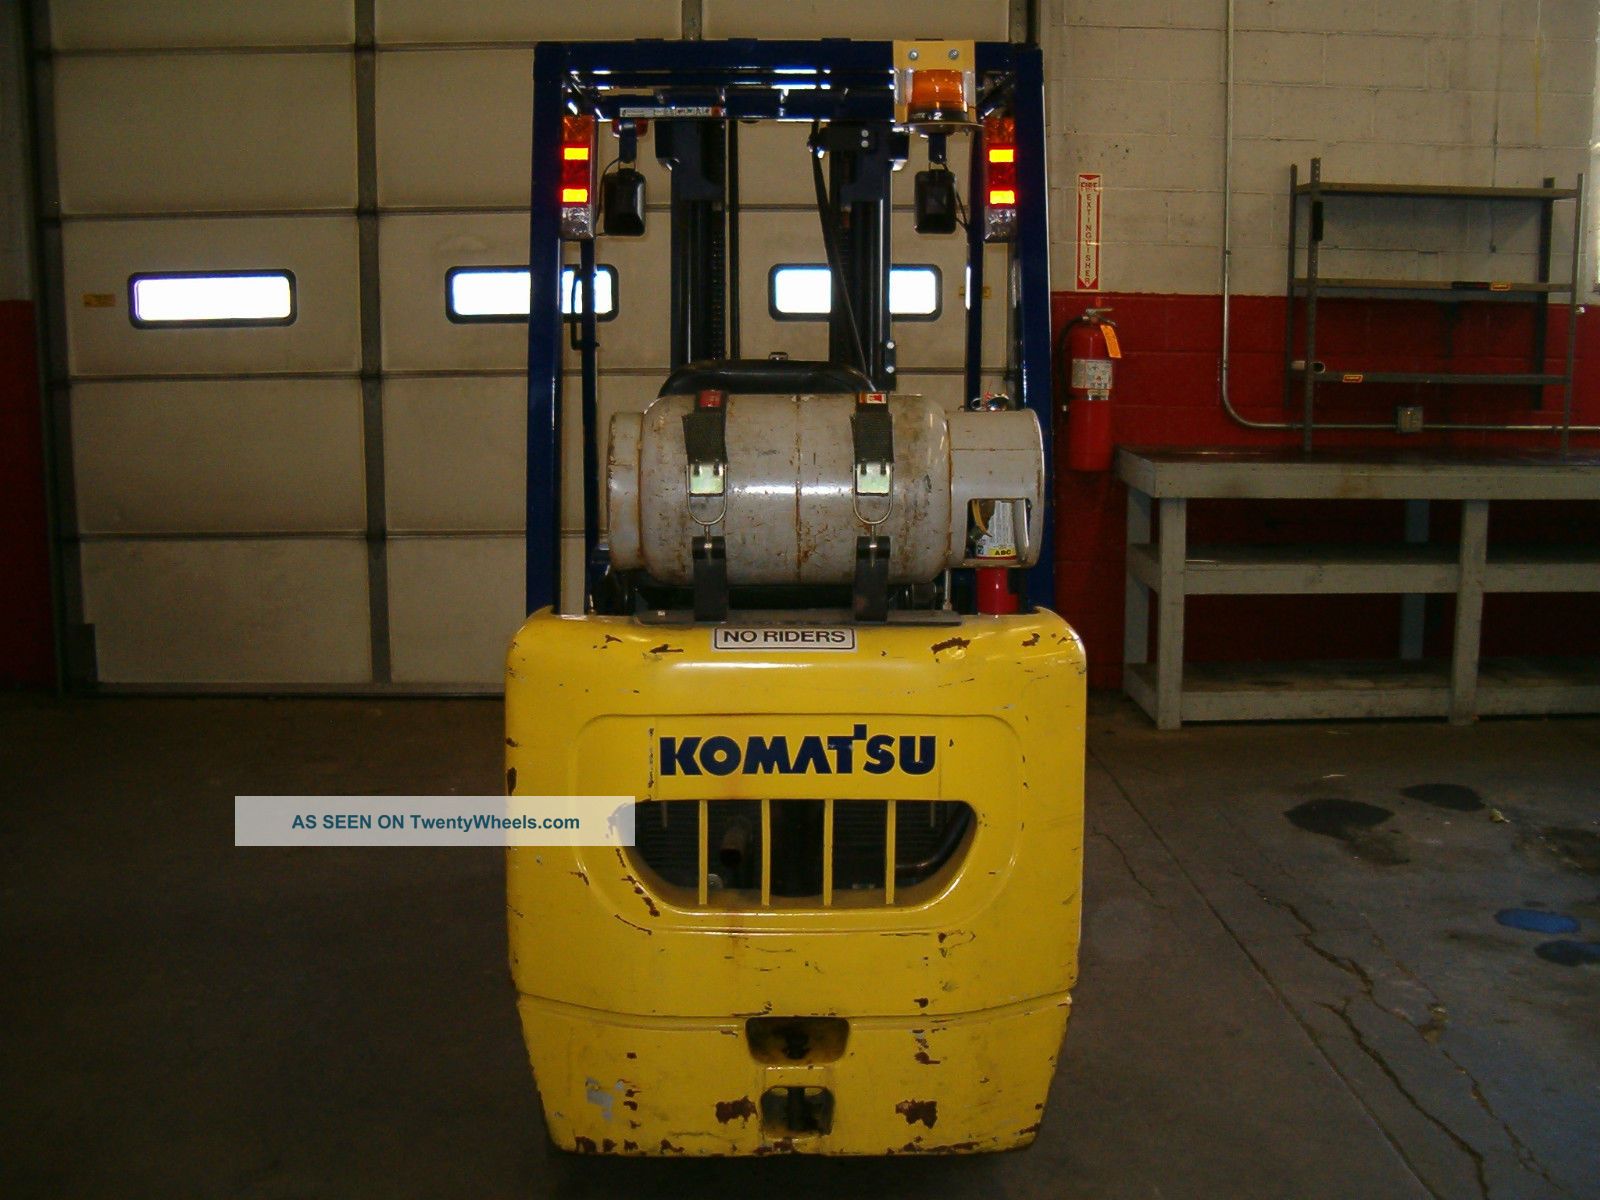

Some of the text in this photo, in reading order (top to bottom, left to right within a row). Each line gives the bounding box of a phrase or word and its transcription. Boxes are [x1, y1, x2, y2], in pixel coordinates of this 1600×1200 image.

[1080, 182, 1098, 191] FIRE
[723, 630, 846, 643] NO RIDERS
[659, 723, 936, 776] KOMATSU
